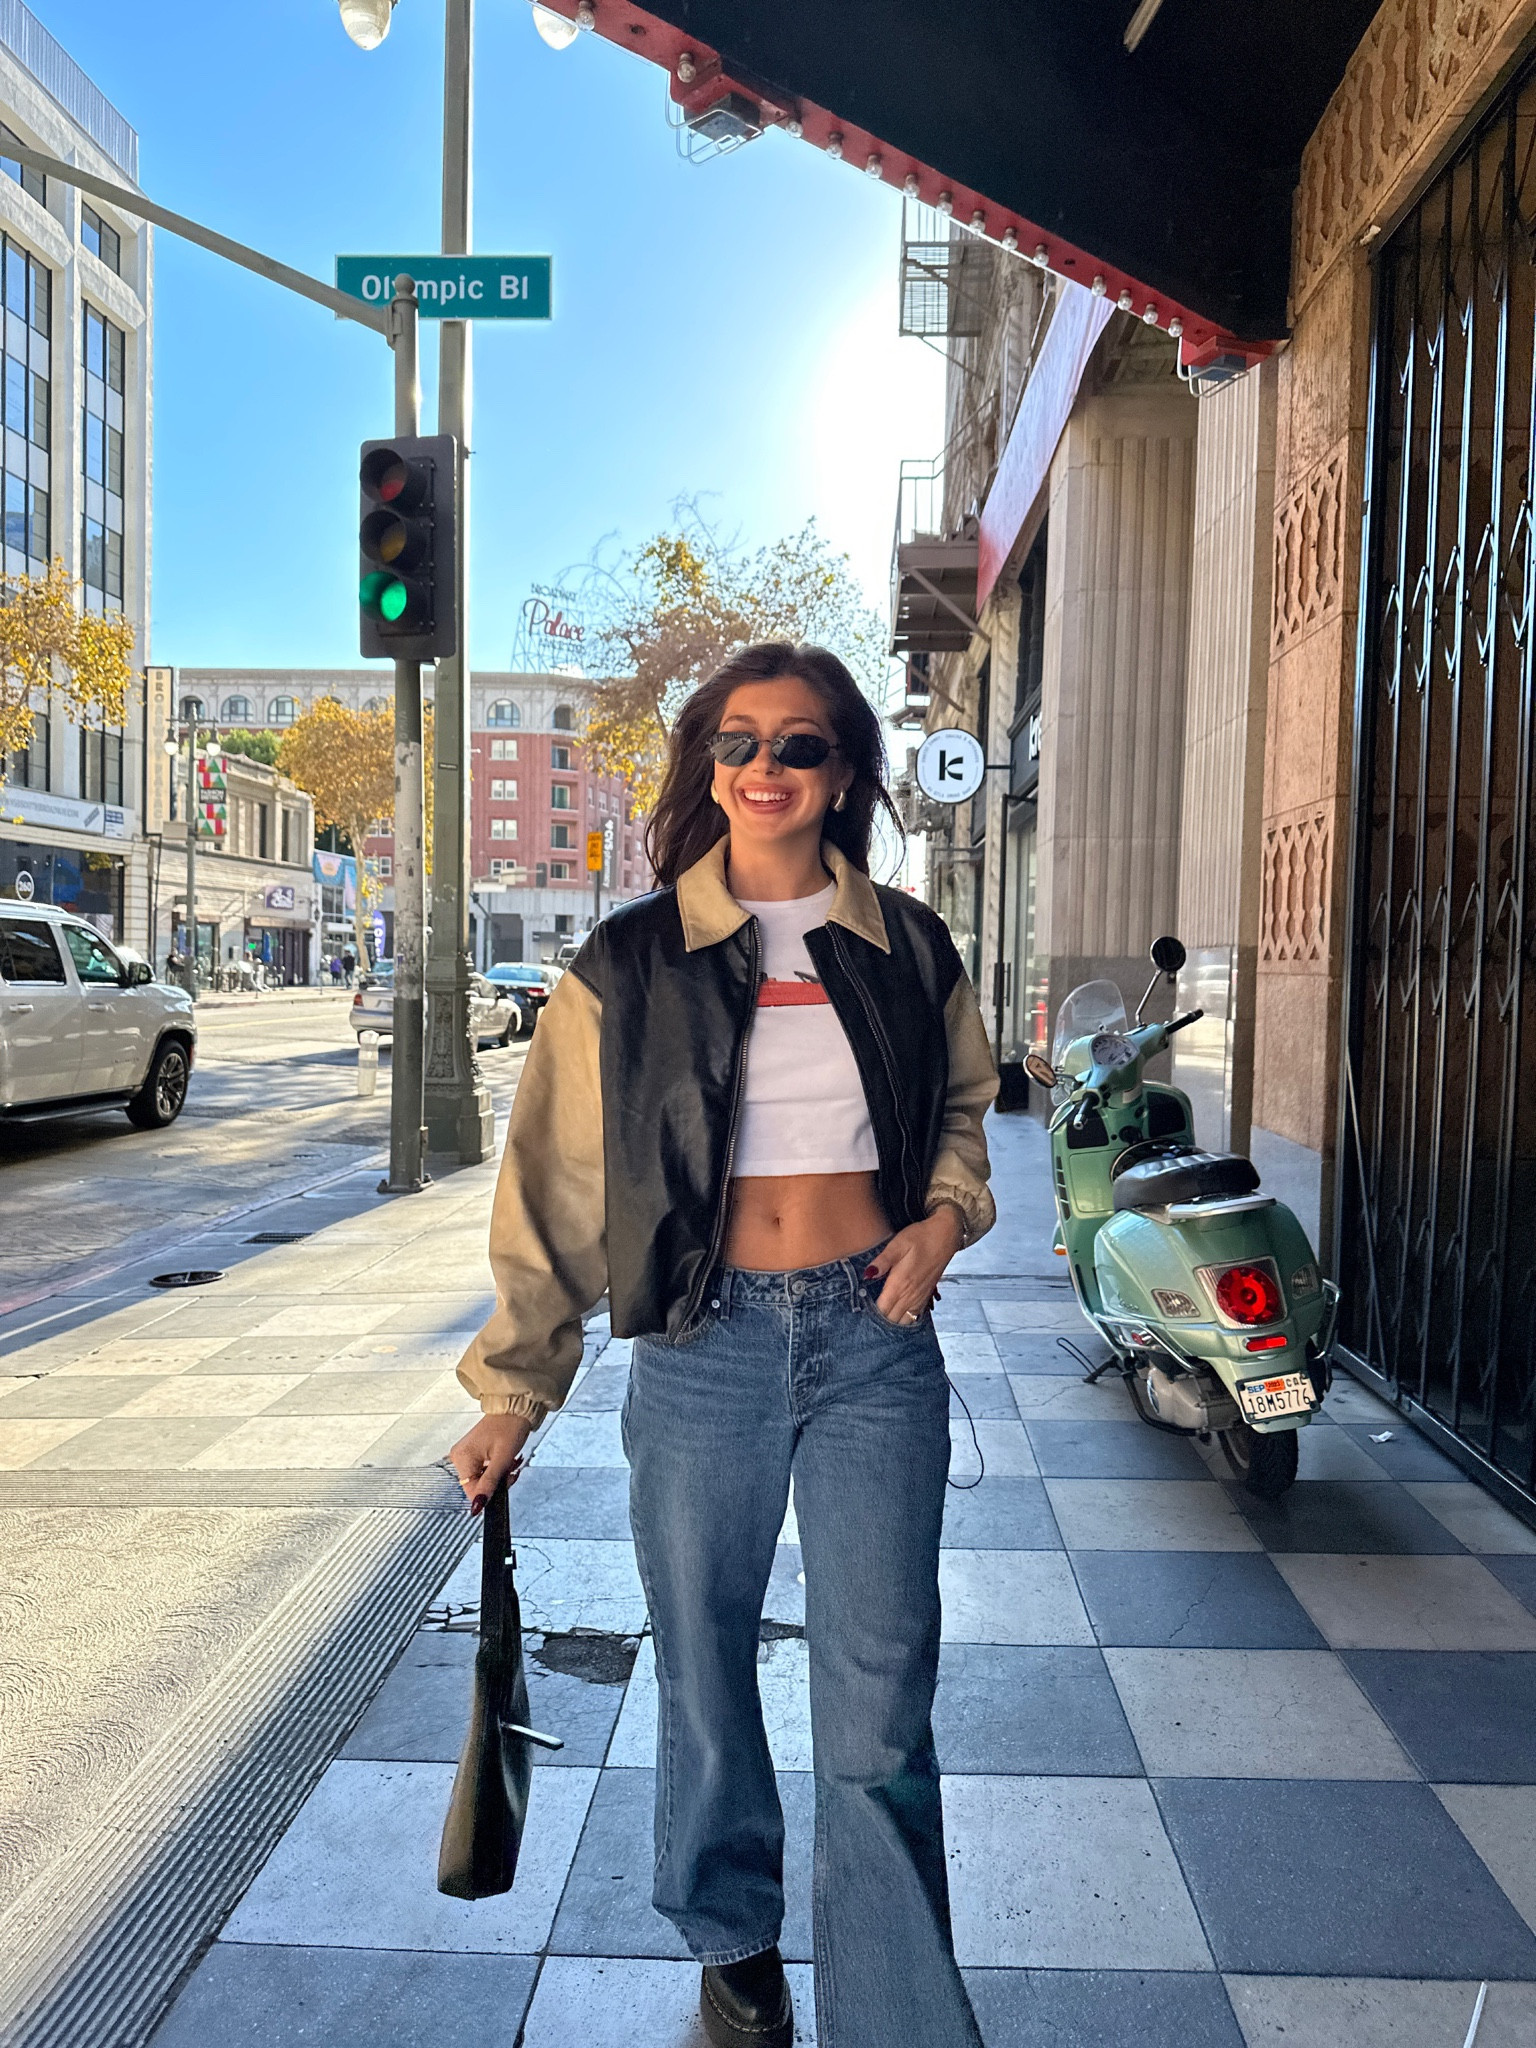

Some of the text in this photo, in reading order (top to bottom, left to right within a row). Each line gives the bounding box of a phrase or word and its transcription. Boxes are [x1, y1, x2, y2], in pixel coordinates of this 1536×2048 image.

[361, 274, 528, 305] Olmpic Bl
[523, 598, 586, 642] Palace
[1247, 1384, 1265, 1394] SEP
[1248, 1388, 1310, 1414] 18M5776
